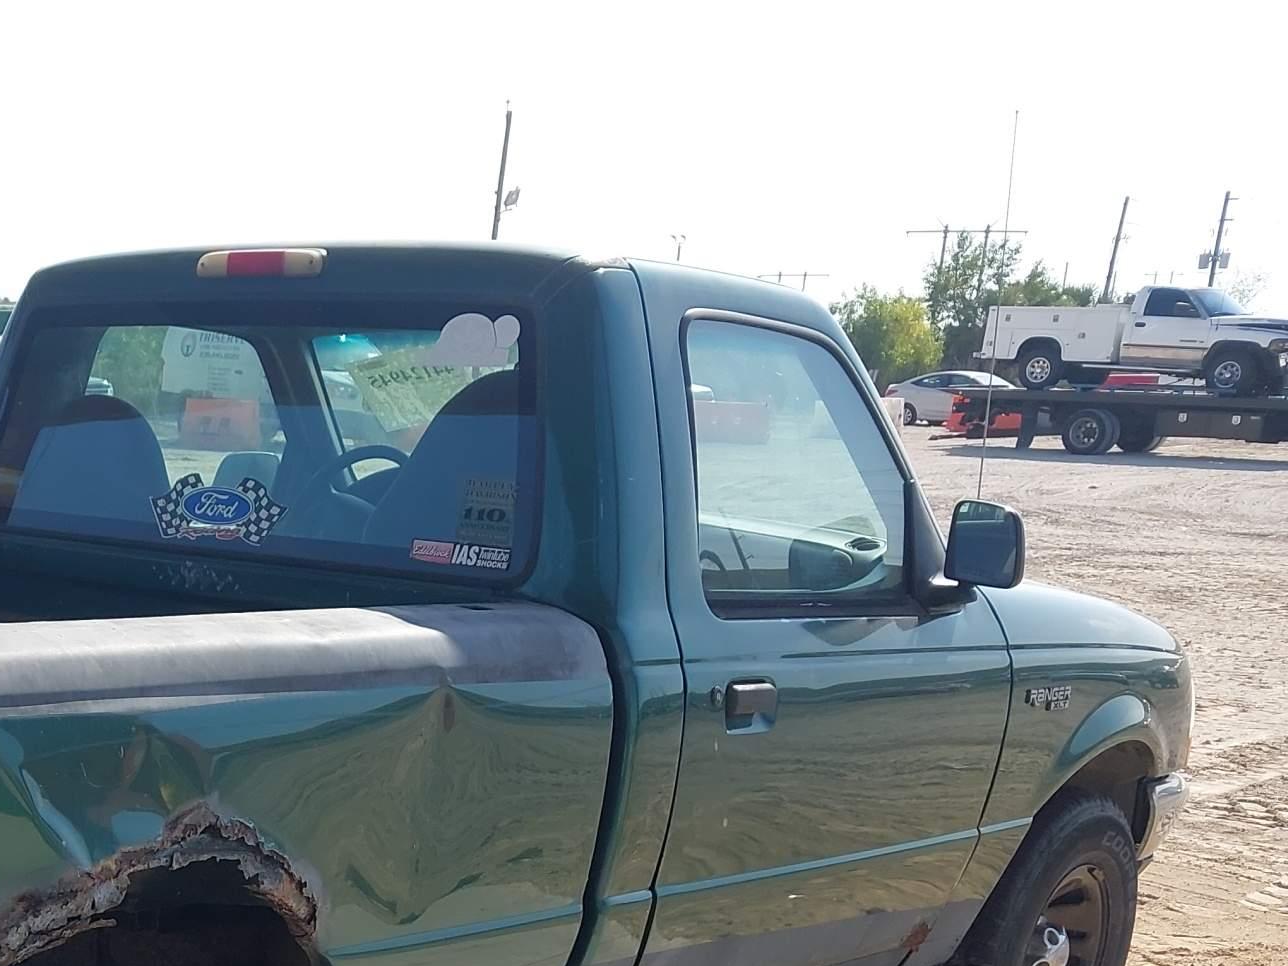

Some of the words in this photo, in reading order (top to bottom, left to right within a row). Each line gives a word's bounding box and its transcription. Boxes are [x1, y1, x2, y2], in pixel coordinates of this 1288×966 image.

[194, 491, 240, 519] Ford
[463, 505, 507, 522] 110
[452, 544, 479, 566] IAS
[475, 560, 509, 570] SHOCKS
[1028, 686, 1072, 706] RANGER
[1050, 700, 1070, 711] XLT
